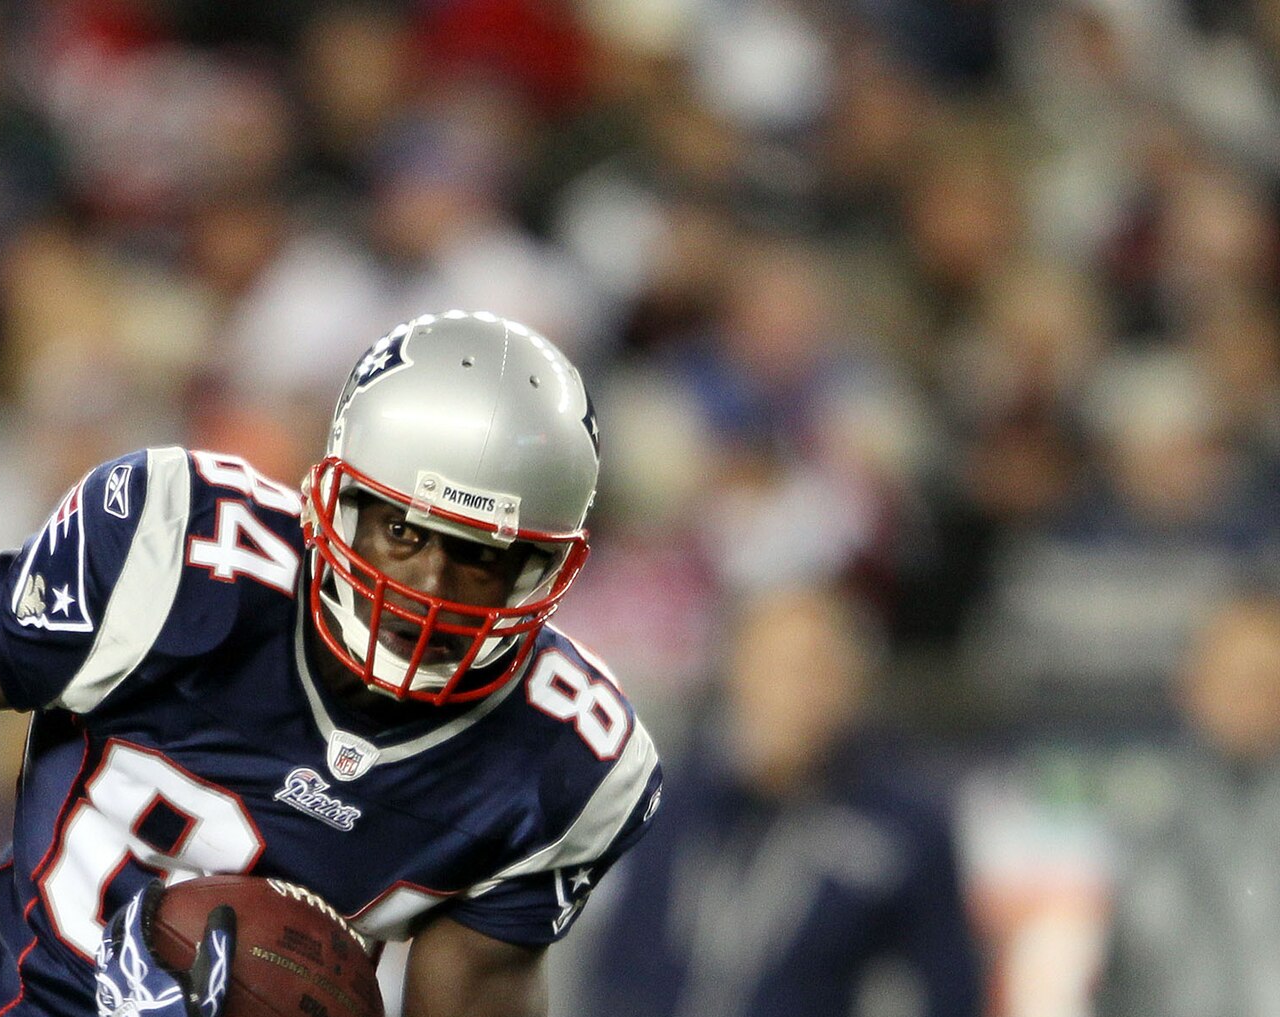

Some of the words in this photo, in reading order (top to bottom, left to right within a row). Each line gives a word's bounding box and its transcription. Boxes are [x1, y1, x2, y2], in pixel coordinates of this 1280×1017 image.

[442, 486, 496, 512] PATRIOTS
[185, 450, 302, 598] 84
[335, 757, 358, 776] NFL
[274, 778, 361, 830] Patriots
